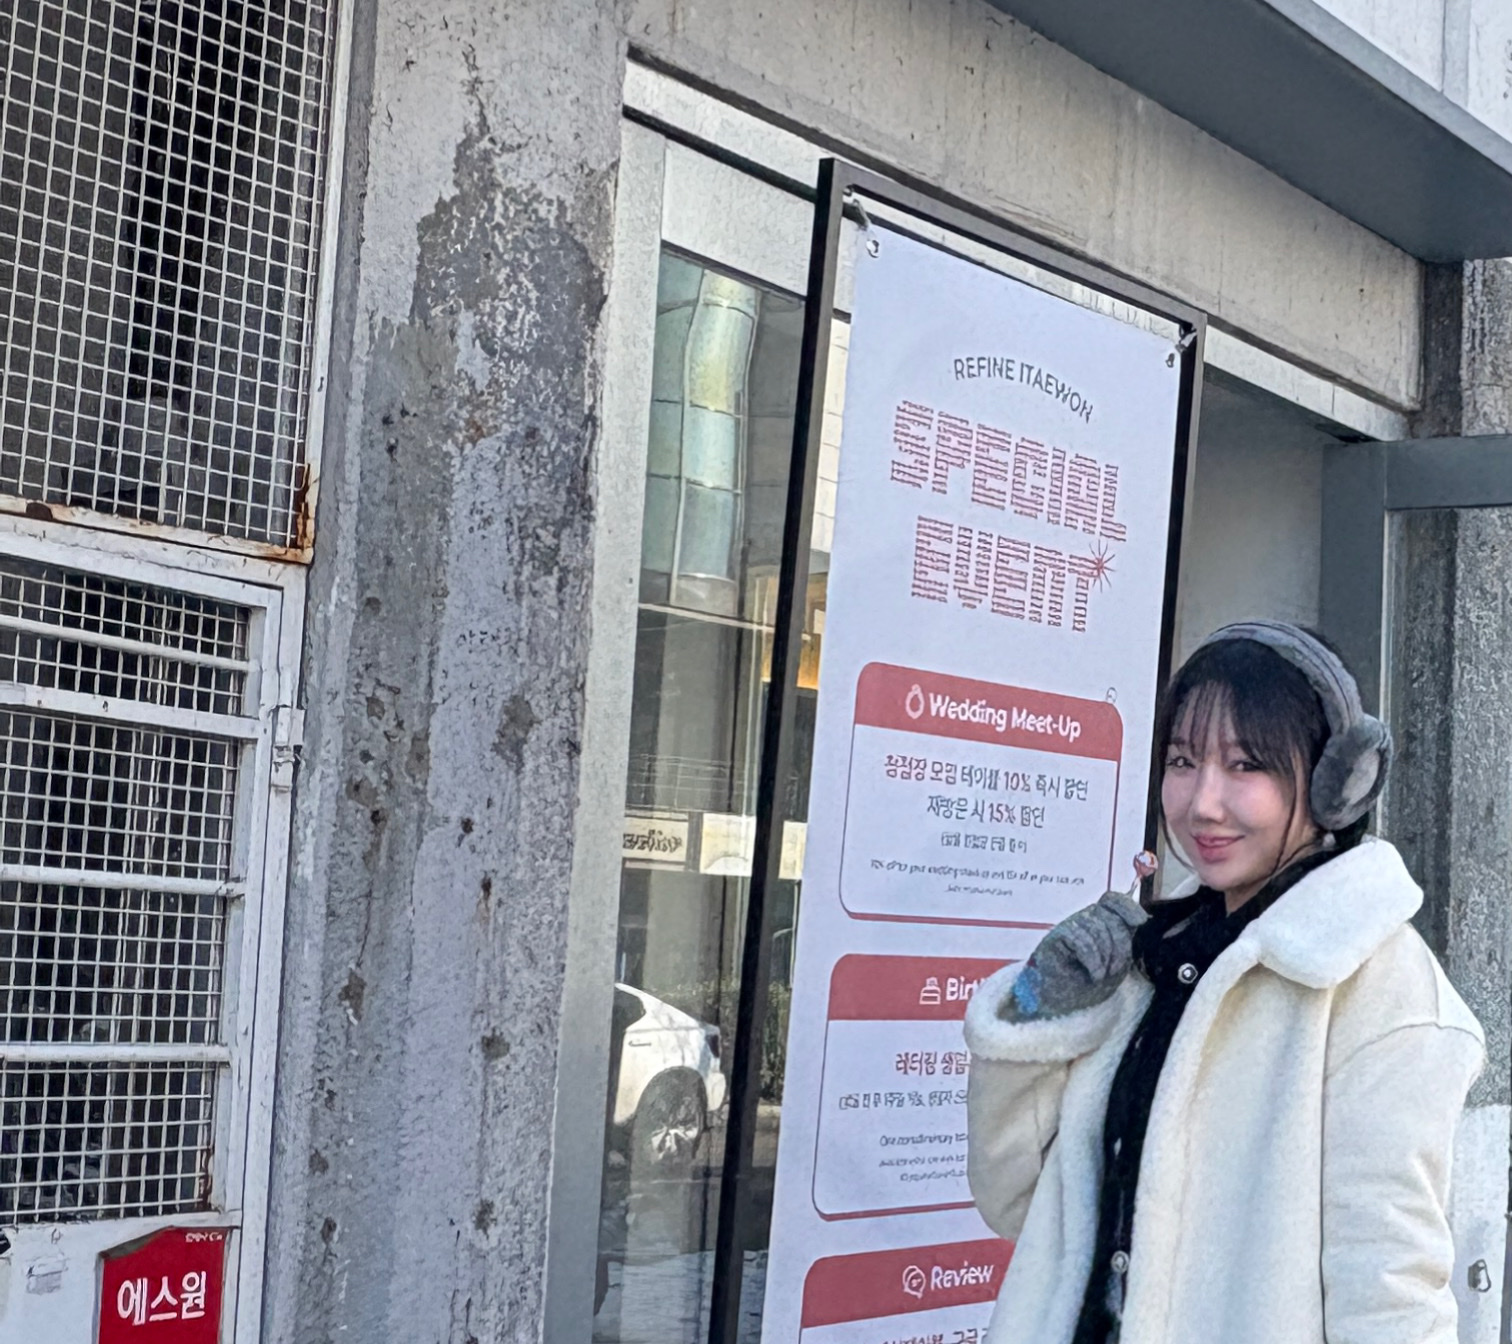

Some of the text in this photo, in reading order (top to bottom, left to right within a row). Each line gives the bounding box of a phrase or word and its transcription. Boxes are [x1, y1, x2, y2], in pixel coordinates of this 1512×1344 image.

[953, 356, 1094, 424] REFINE ITAEWON
[889, 399, 1128, 543] SPECIAL
[910, 514, 1095, 634] EVENT
[928, 692, 1082, 743] Wedding Meet-Up
[930, 760, 958, 785] 모임
[961, 764, 1000, 791] 테이블
[1003, 770, 1031, 793] 10%
[988, 802, 1016, 825] 15%
[116, 1269, 207, 1327] 에스원
[931, 1260, 995, 1291] Review
